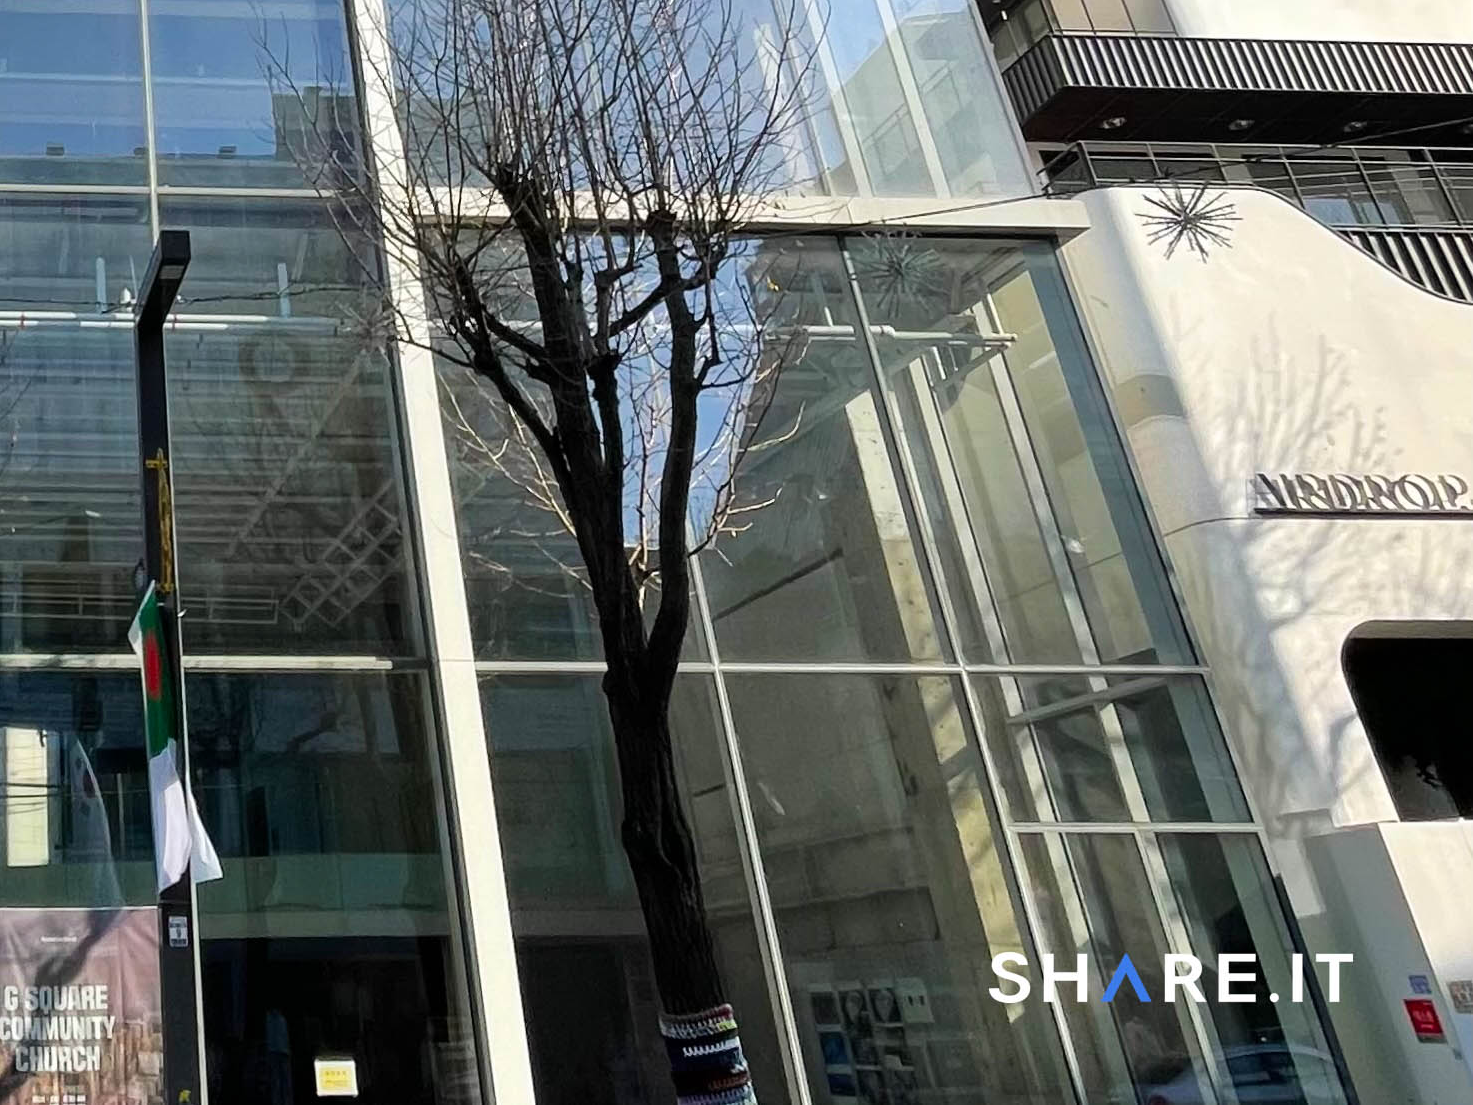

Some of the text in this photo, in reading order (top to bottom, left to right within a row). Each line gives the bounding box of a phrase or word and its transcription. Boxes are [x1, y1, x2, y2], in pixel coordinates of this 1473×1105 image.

[4, 985, 109, 1014] G SQUARE
[15, 1046, 101, 1072] CHURCH
